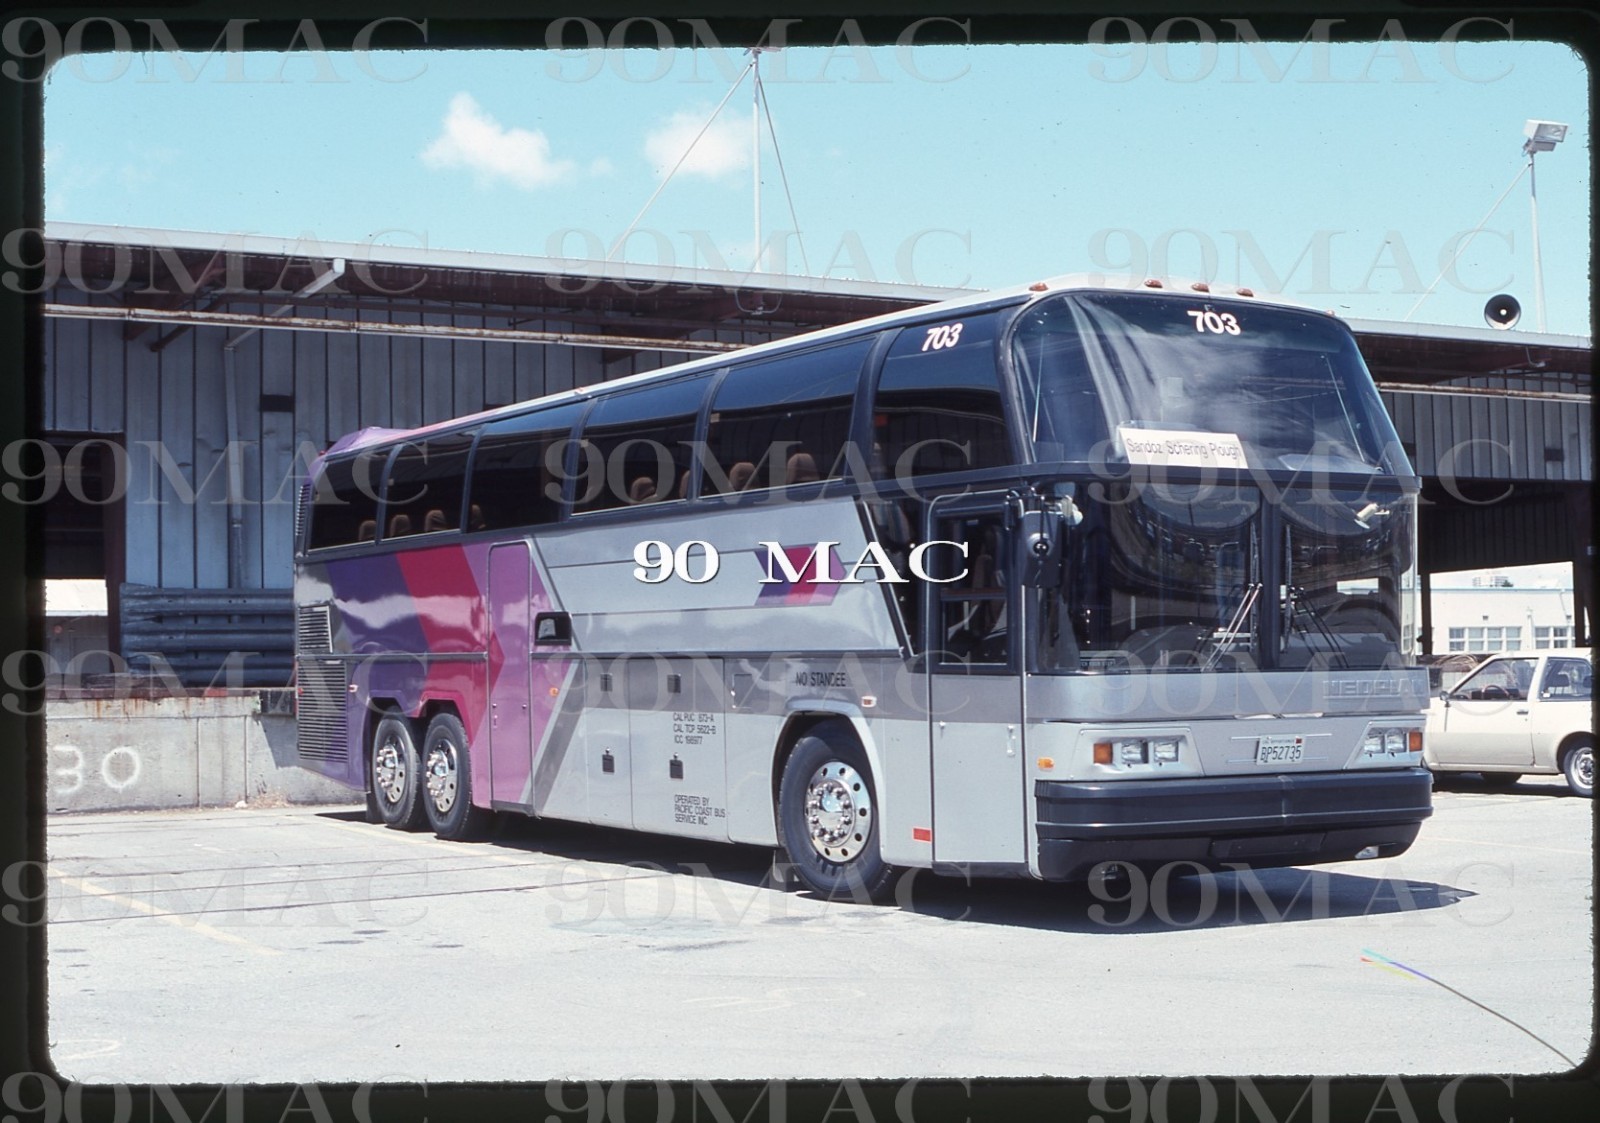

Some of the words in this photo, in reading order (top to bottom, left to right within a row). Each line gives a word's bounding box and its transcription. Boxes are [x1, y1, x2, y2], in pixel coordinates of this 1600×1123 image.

[1187, 310, 1241, 336] 703
[921, 322, 963, 351] 703
[1126, 437, 1163, 454] Sandoz
[1166, 440, 1207, 458] Schering
[1209, 442, 1241, 459] Plough
[796, 671, 808, 687] NO
[810, 671, 846, 687] STANDEE
[1260, 745, 1302, 761] BP52735
[674, 794, 700, 805] OPERATED
[702, 796, 709, 806] BY
[674, 804, 693, 814] PACIFIC
[694, 806, 712, 816] COAST
[714, 808, 725, 818] BUS
[674, 813, 696, 824] SERVICE
